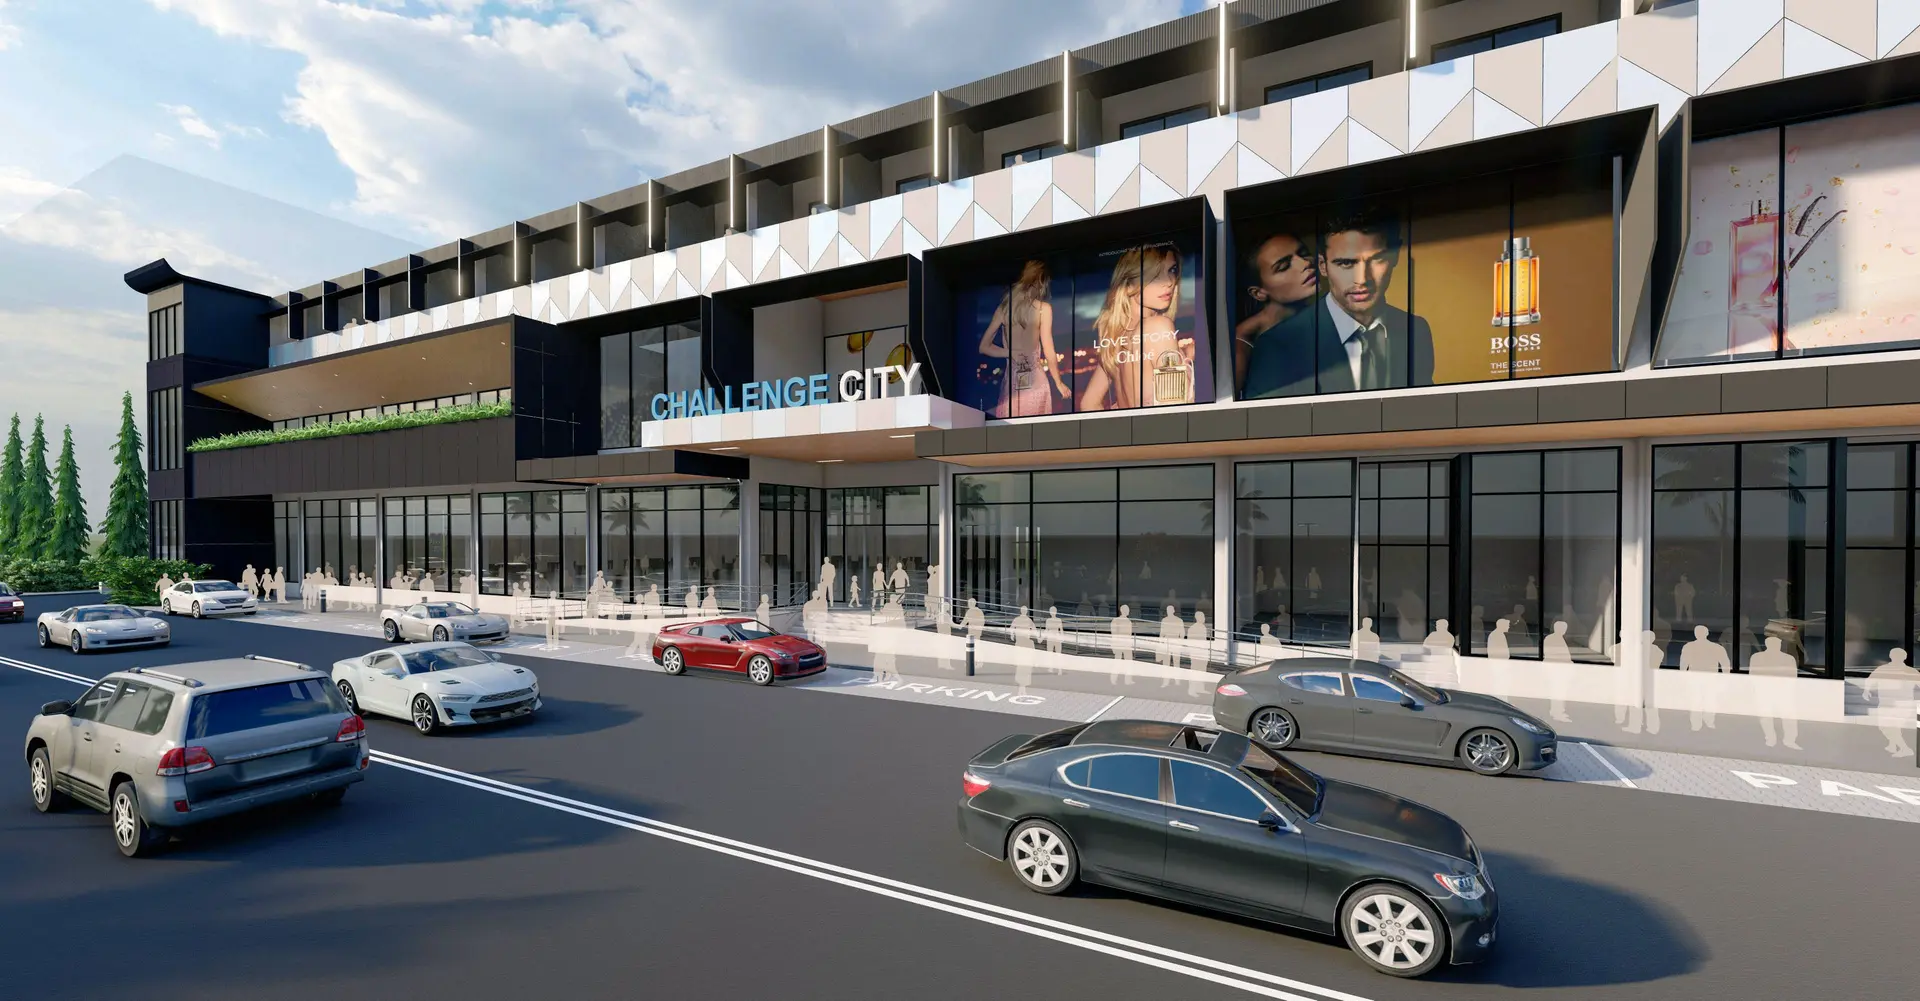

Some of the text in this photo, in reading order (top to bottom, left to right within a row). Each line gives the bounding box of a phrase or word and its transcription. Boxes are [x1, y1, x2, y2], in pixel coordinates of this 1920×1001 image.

[1093, 329, 1180, 349] LOVE STORY
[1491, 333, 1541, 349] BOSS
[1116, 349, 1155, 364] Chloé
[1490, 359, 1541, 369] THE SCENT
[650, 373, 830, 420] CHALLENGE
[840, 362, 922, 402] CITY
[841, 677, 1047, 705] PARKING
